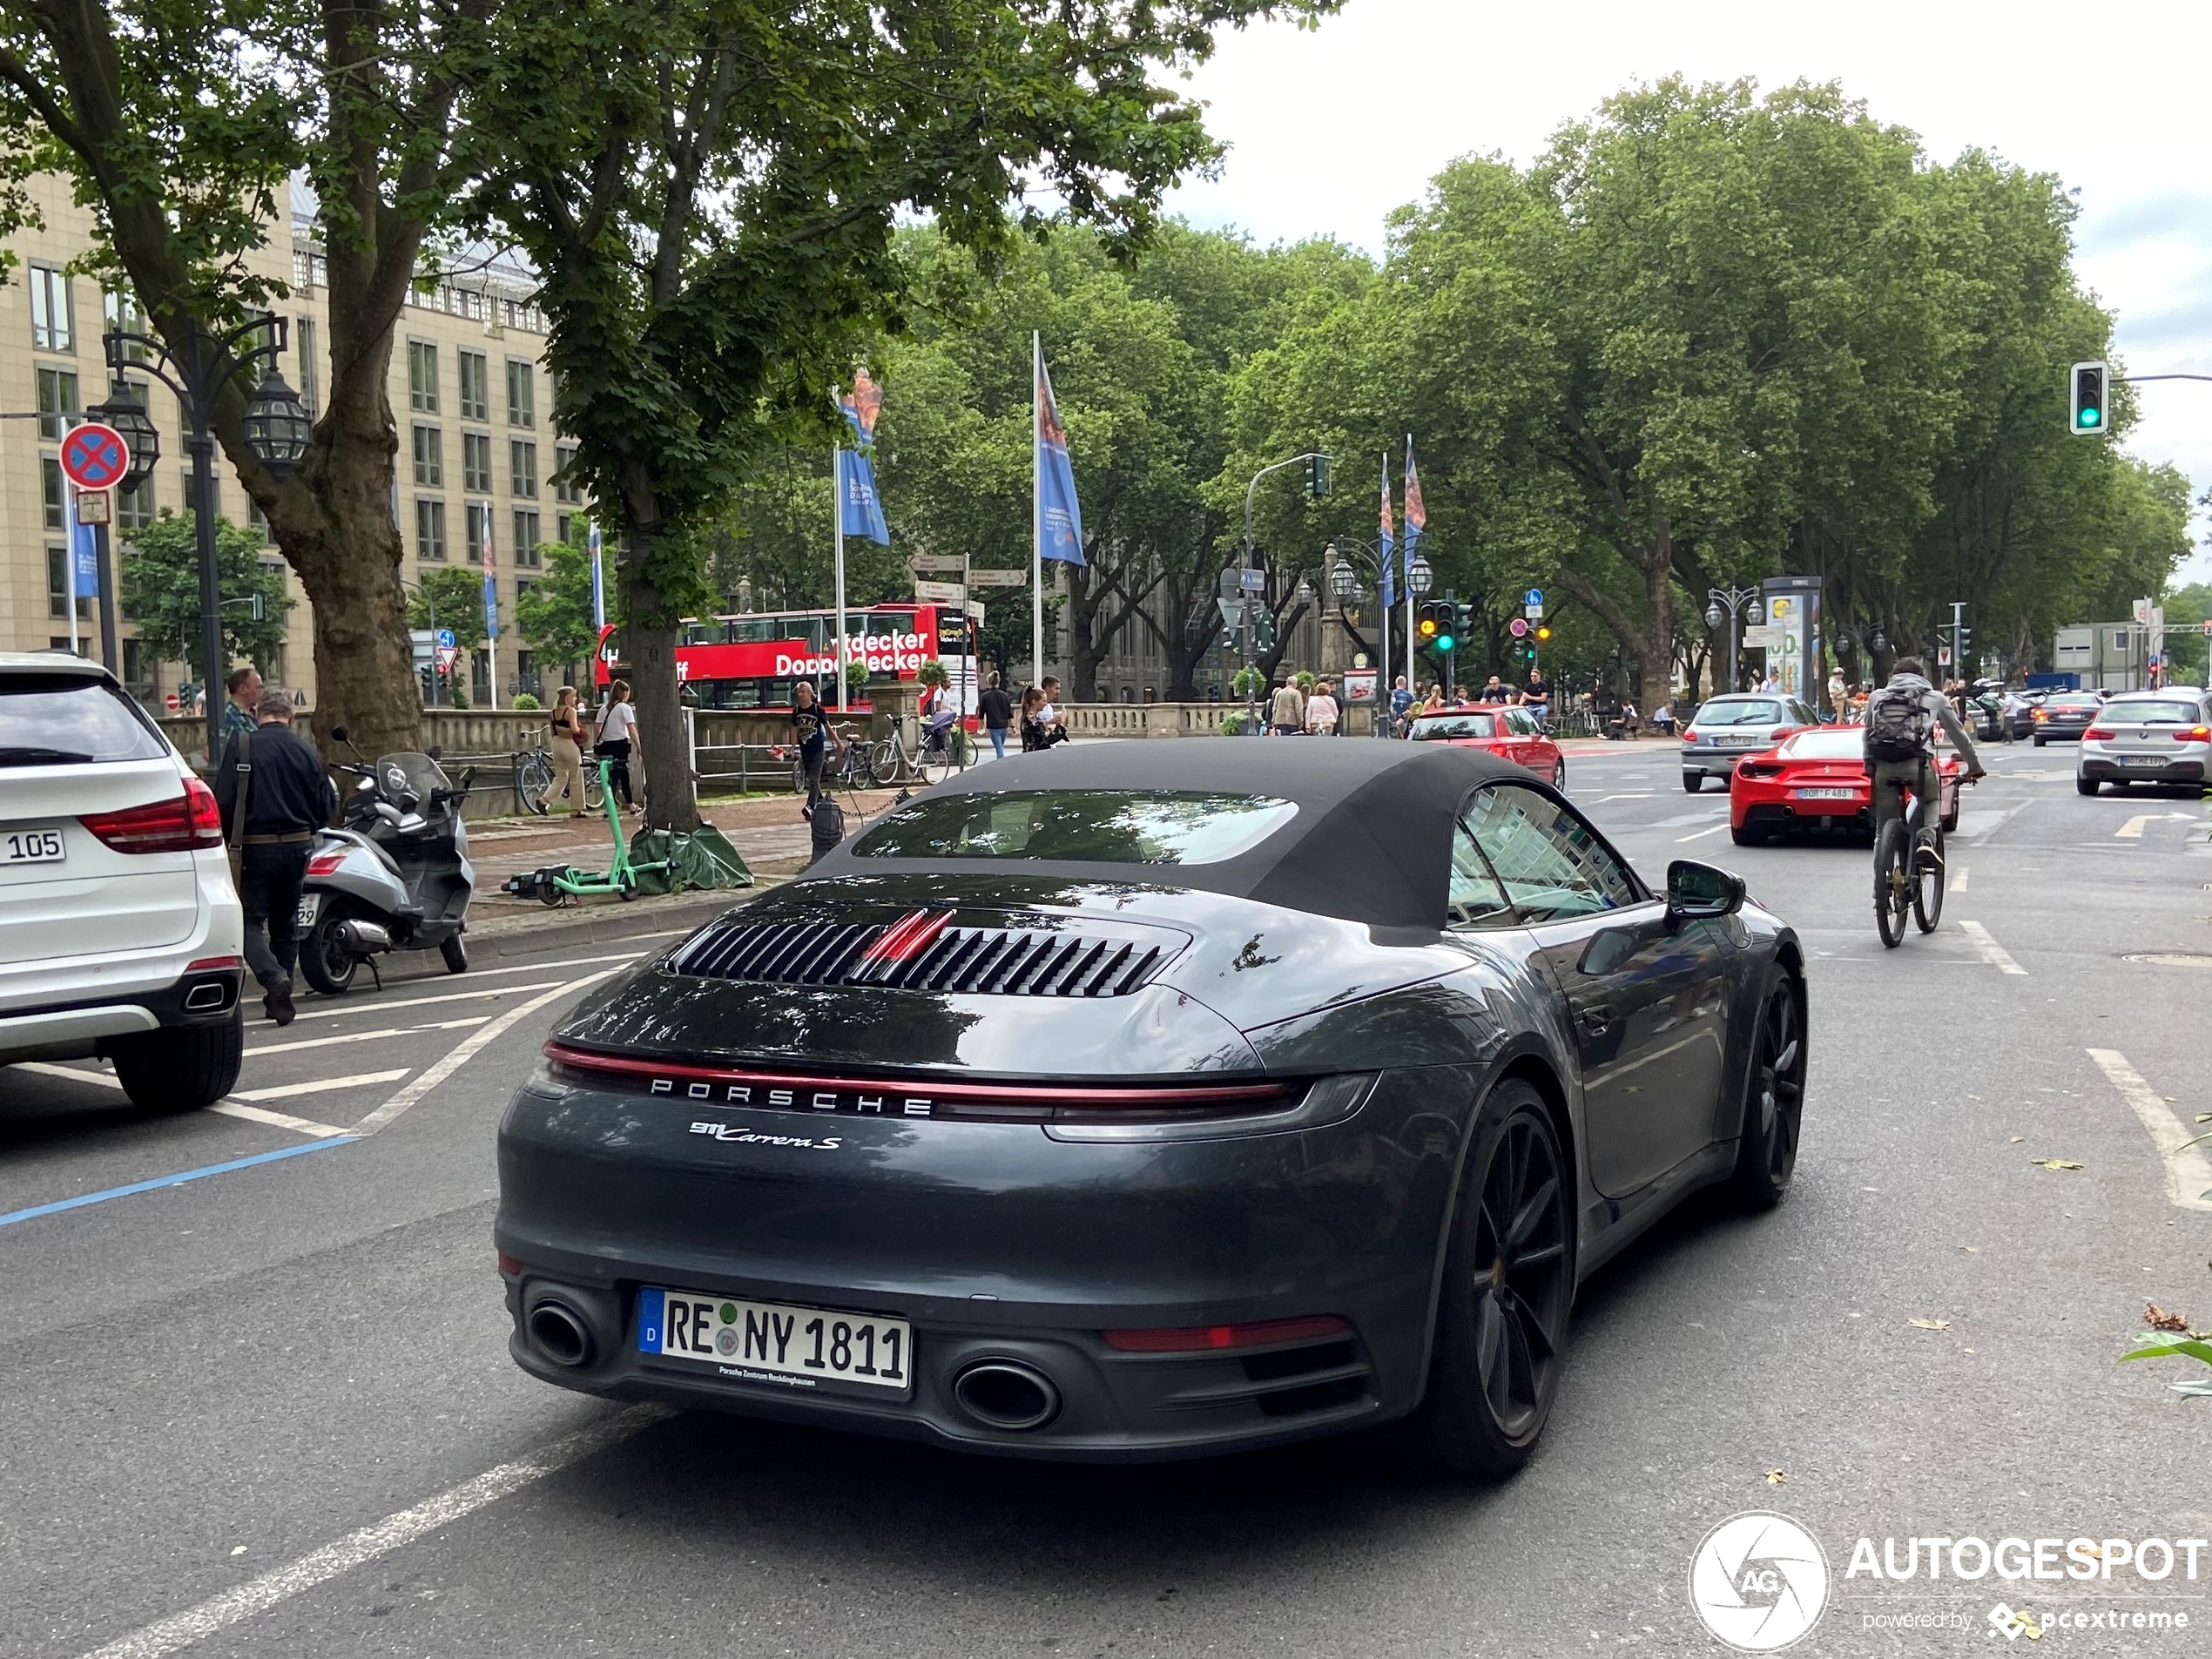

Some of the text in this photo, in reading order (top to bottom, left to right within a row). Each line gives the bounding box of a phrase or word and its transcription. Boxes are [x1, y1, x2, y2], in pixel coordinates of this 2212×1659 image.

[8, 833, 60, 859] 105
[651, 1079, 932, 1116] PORSCHE
[689, 1122, 843, 1150] 911 Carrera S
[646, 1327, 656, 1342] D
[666, 1299, 903, 1381] RE NY 1811
[718, 1366, 742, 1377] Porsche
[743, 1369, 768, 1380] Zentrum
